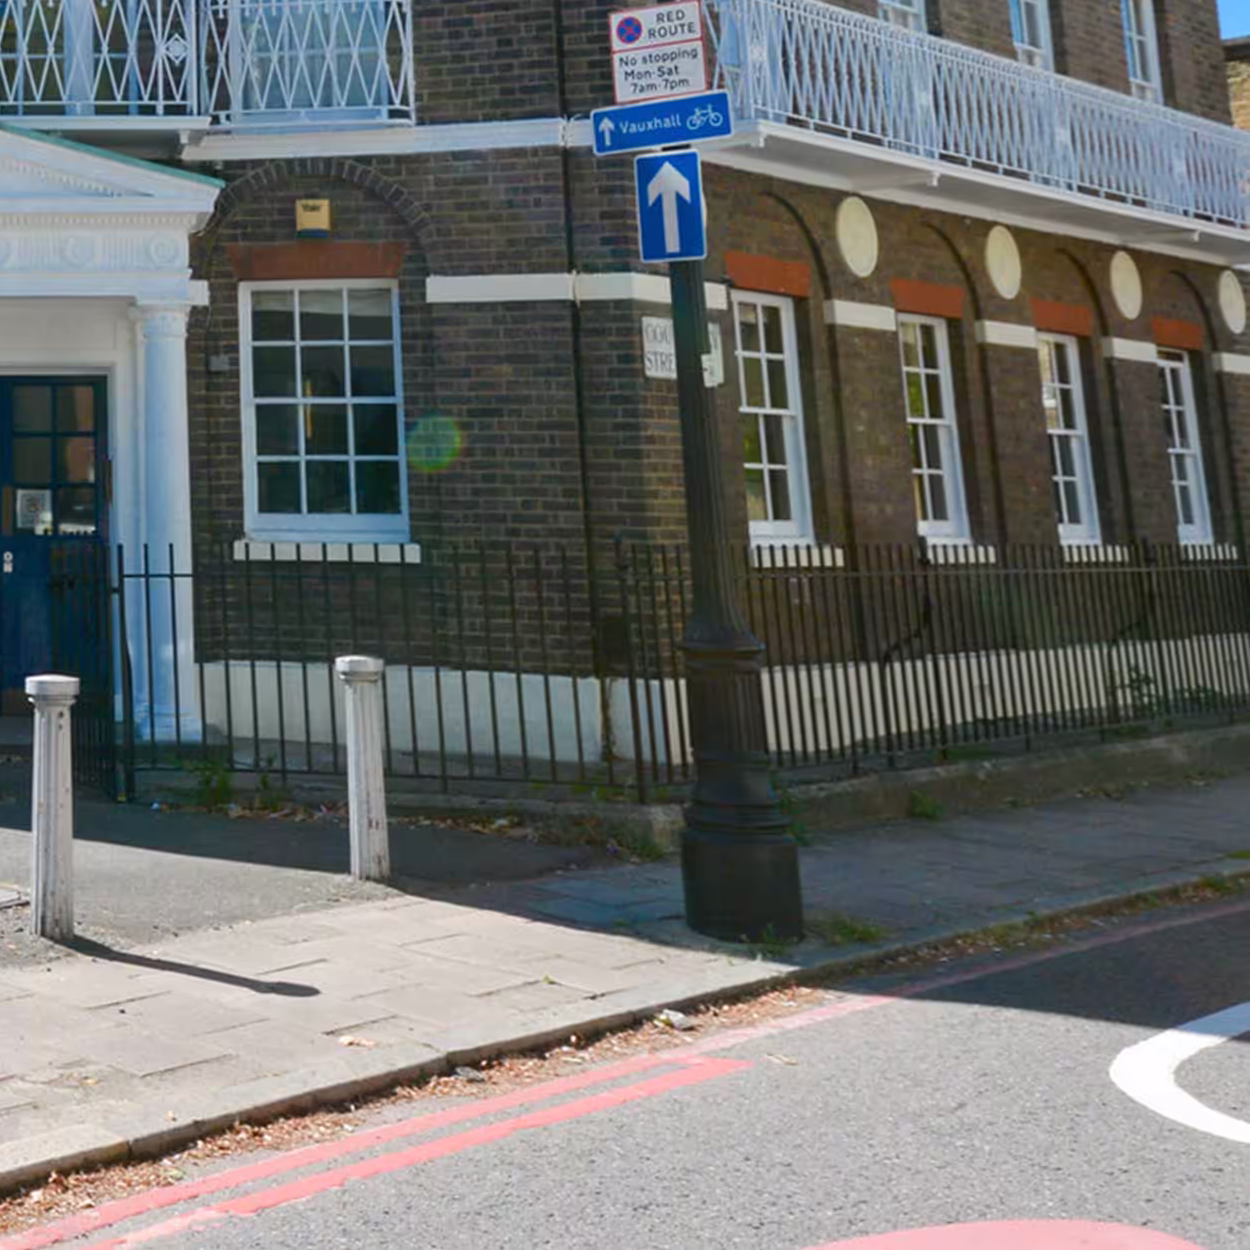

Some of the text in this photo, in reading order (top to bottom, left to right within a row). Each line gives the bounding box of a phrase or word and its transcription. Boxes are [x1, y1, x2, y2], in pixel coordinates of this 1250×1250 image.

[656, 9, 686, 23] RED
[648, 21, 696, 39] ROUTE
[619, 47, 698, 67] No stopping
[619, 113, 682, 134] Vauxhall
